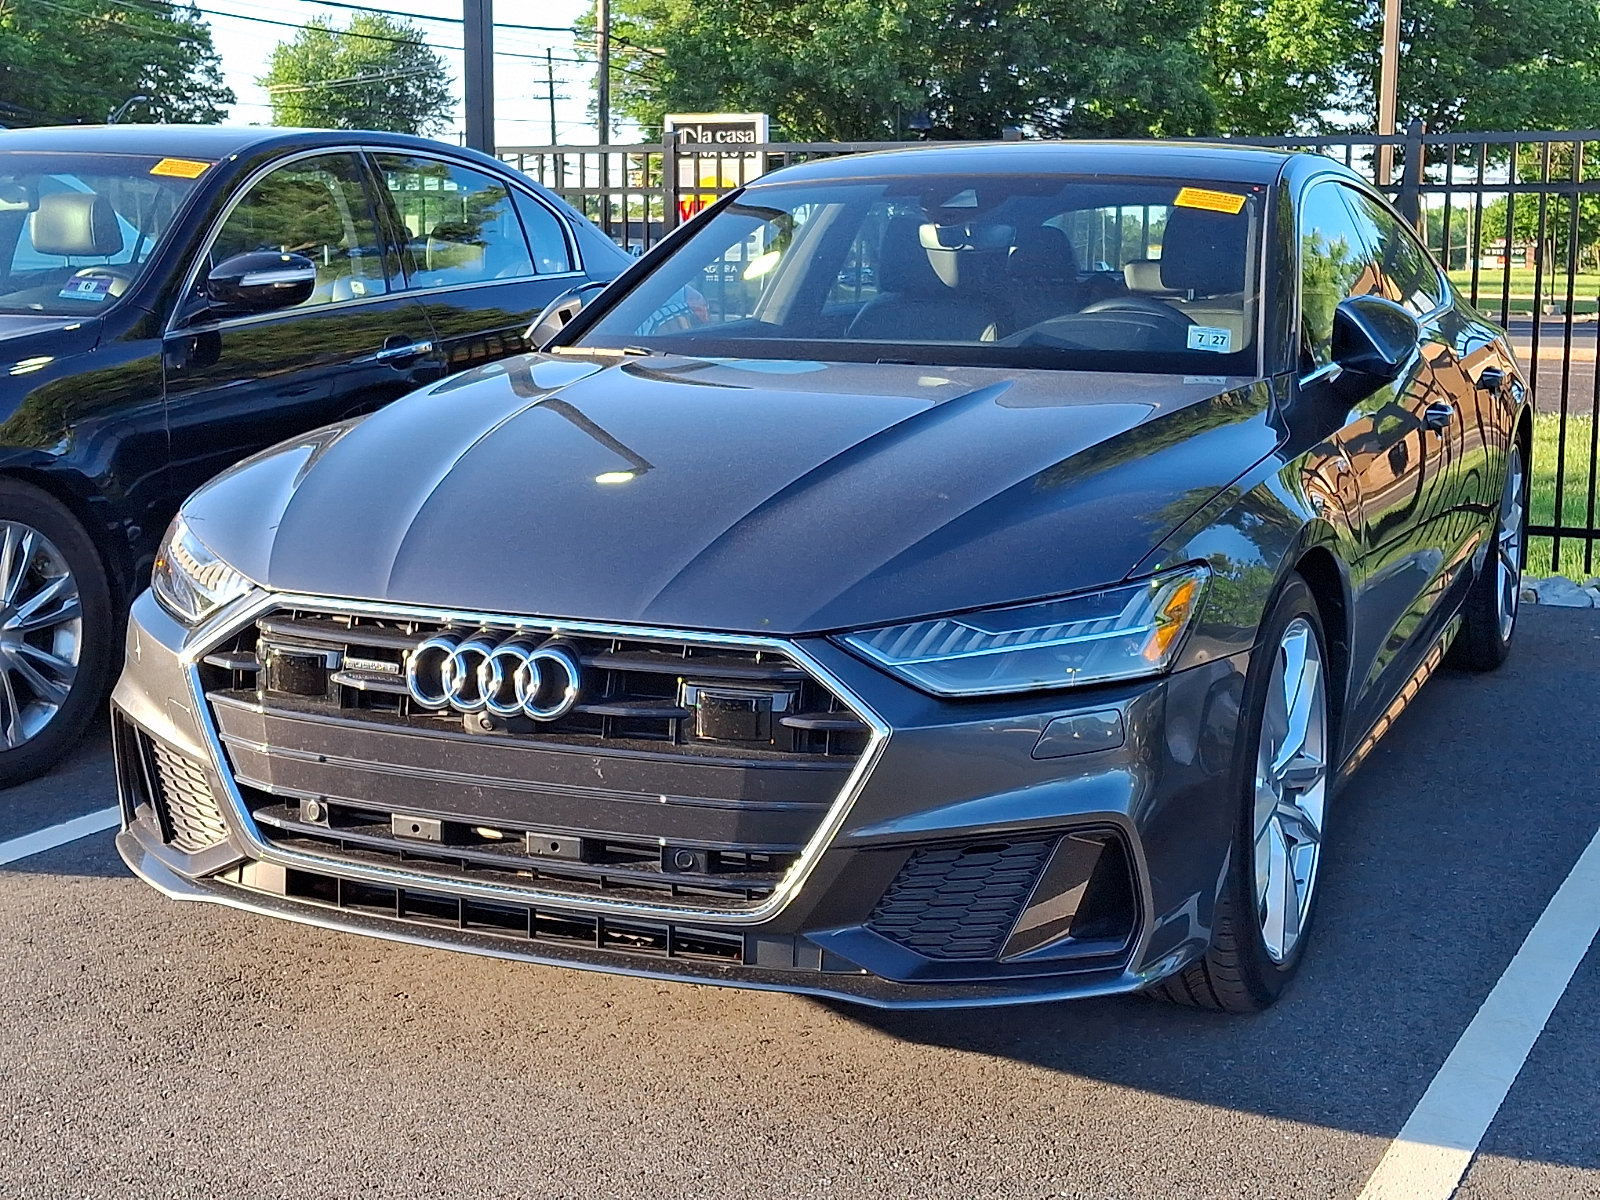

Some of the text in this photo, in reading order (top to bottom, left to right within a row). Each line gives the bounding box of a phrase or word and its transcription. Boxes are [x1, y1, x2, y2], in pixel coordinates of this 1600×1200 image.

[715, 129, 755, 143] casa
[84, 282, 92, 291] 6
[1197, 333, 1227, 346] 7 27
